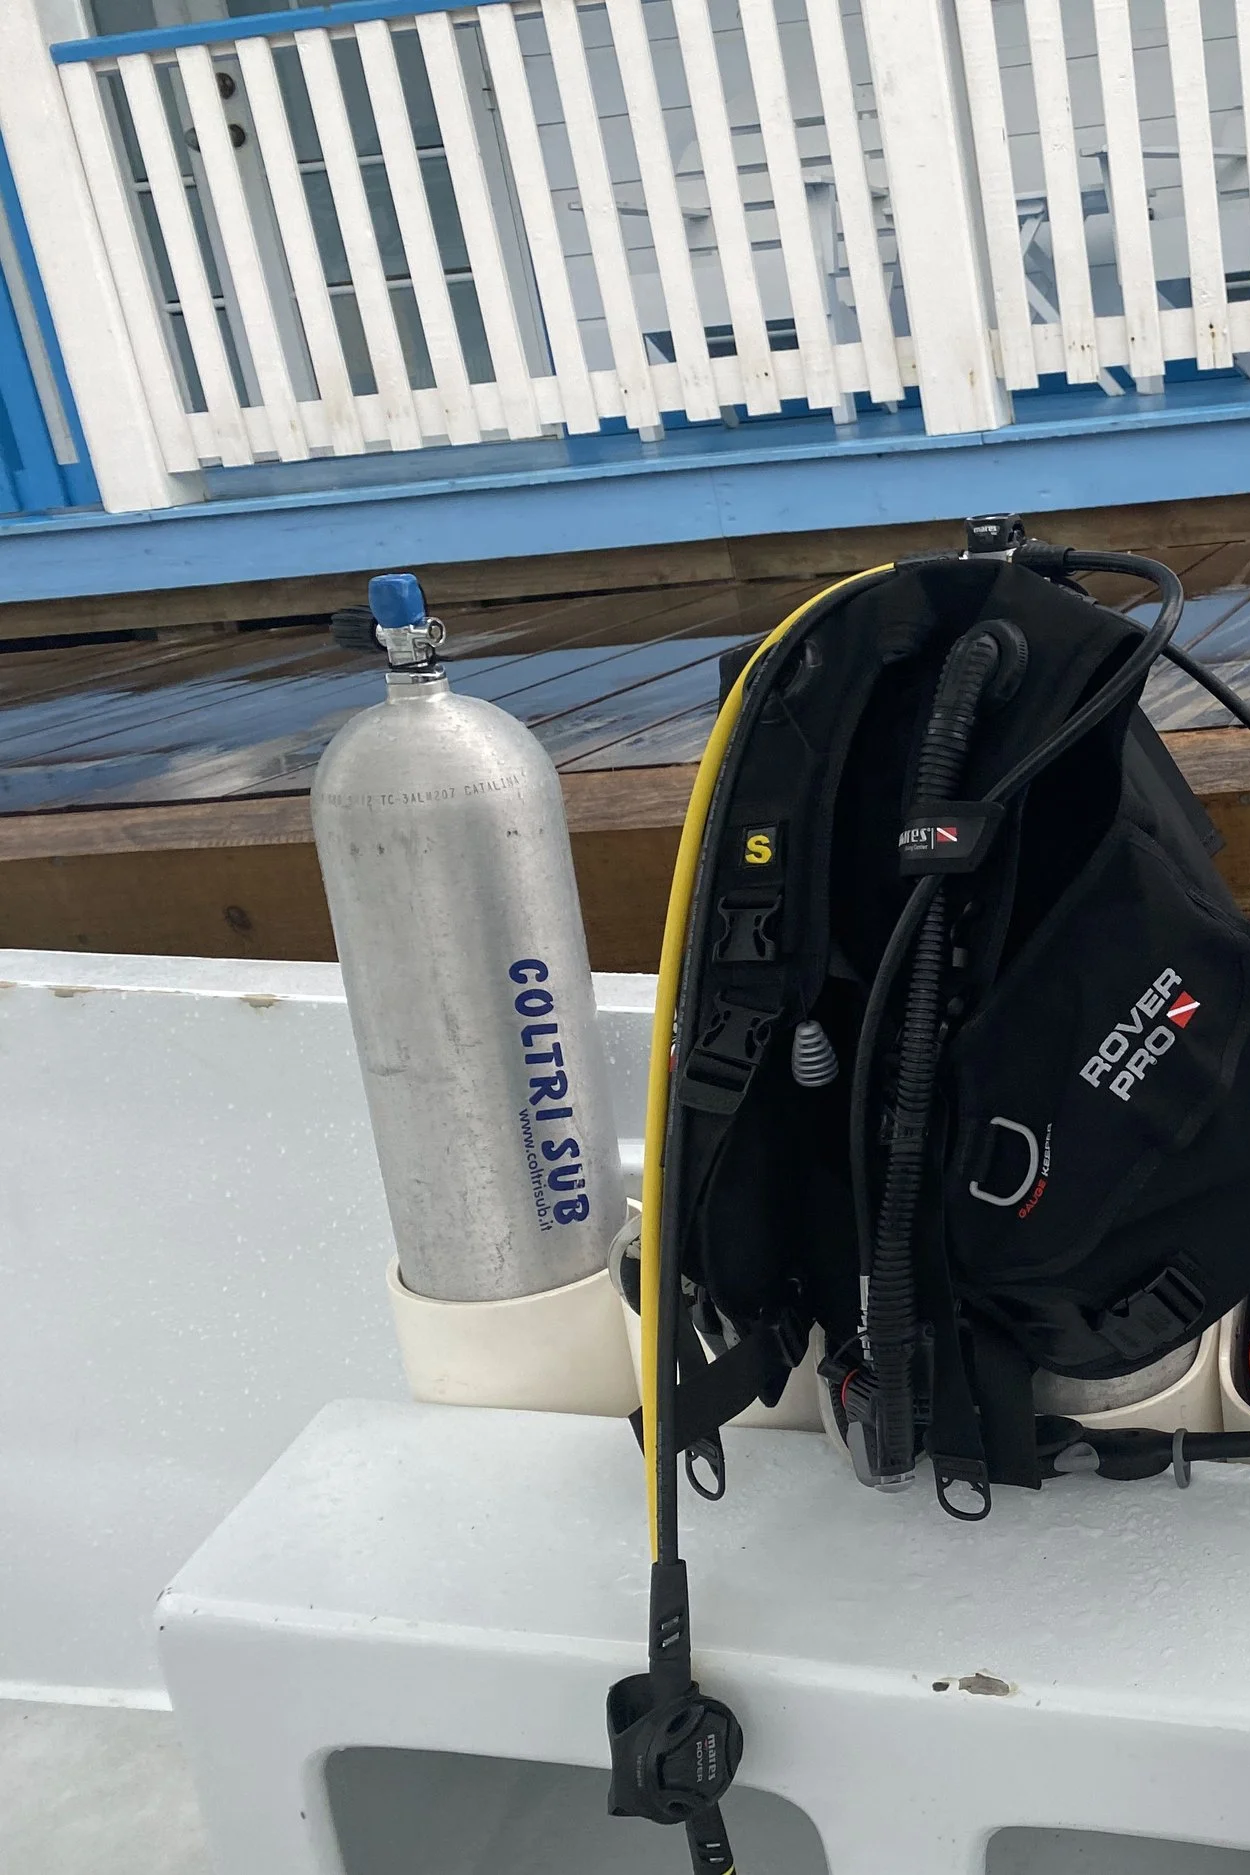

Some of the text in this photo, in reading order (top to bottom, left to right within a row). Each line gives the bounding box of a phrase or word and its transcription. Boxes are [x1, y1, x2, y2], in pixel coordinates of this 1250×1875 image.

[745, 835, 772, 864] S
[899, 827, 927, 847] ares
[1079, 967, 1182, 1088] ROVER
[509, 958, 590, 1225] COLTRI SUB
[1109, 1025, 1175, 1101] PRO
[518, 1108, 553, 1233] www.coltrisub.it
[1018, 1179, 1048, 1219] GAUGE
[707, 1733, 717, 1781] mares
